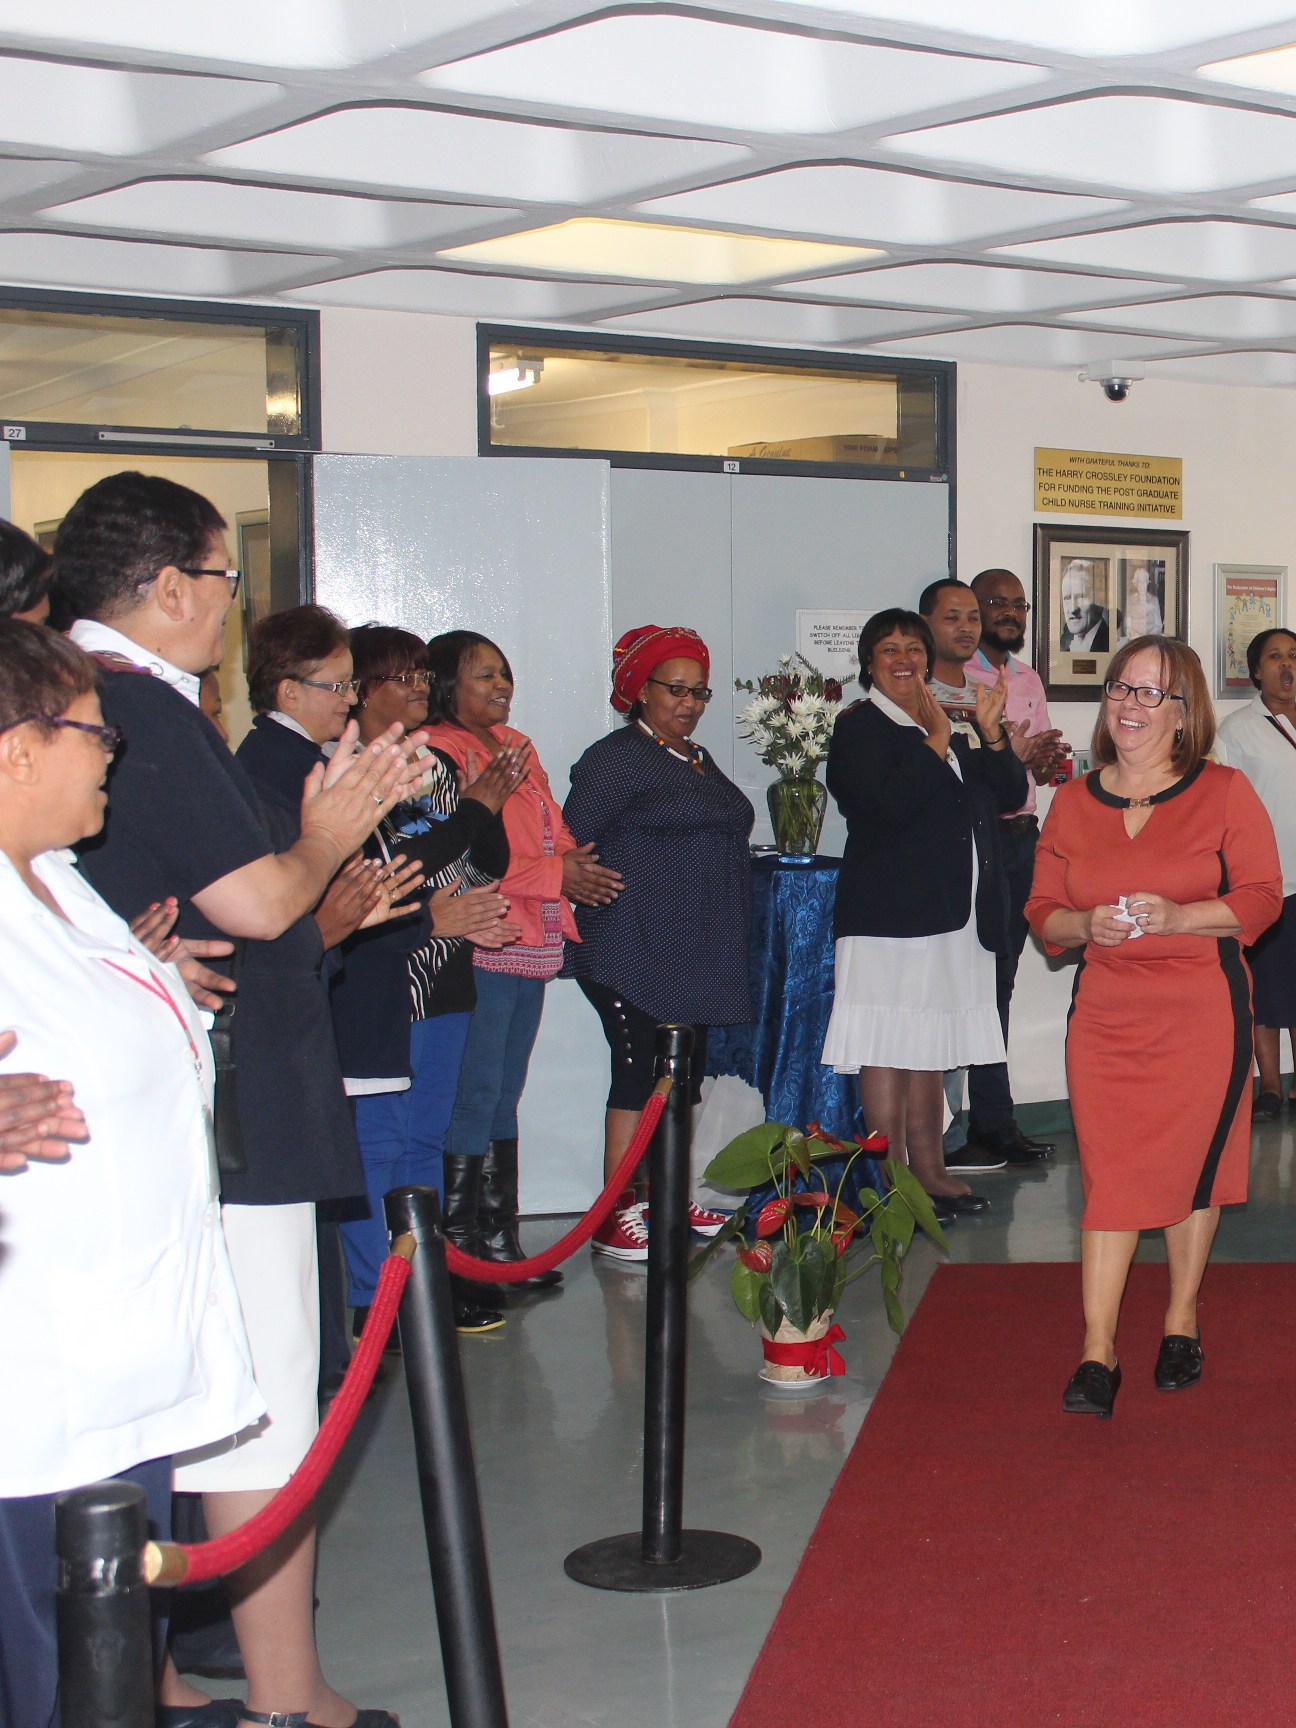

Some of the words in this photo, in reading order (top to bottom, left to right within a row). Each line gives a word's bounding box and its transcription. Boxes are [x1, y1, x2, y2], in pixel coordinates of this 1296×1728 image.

[8, 428, 21, 438] 27
[727, 463, 736, 471] 12
[1085, 458, 1115, 466] GRATEFUL
[1117, 460, 1140, 468] THANKS
[1037, 468, 1054, 477] THE
[1055, 469, 1083, 479] HARRY
[1085, 471, 1128, 482] CROSSLEY
[1130, 474, 1180, 486] FOUNDATION
[1038, 482, 1056, 491] FOR
[1058, 484, 1094, 494] FUNDING
[1096, 486, 1111, 495] THE
[1114, 487, 1135, 497] POST
[1137, 489, 1179, 500] GRADUATE
[1042, 497, 1066, 507] CHILD
[1068, 499, 1096, 509] NURSE
[1098, 501, 1135, 511] TRAINING
[1137, 503, 1176, 513] INITIATIVE
